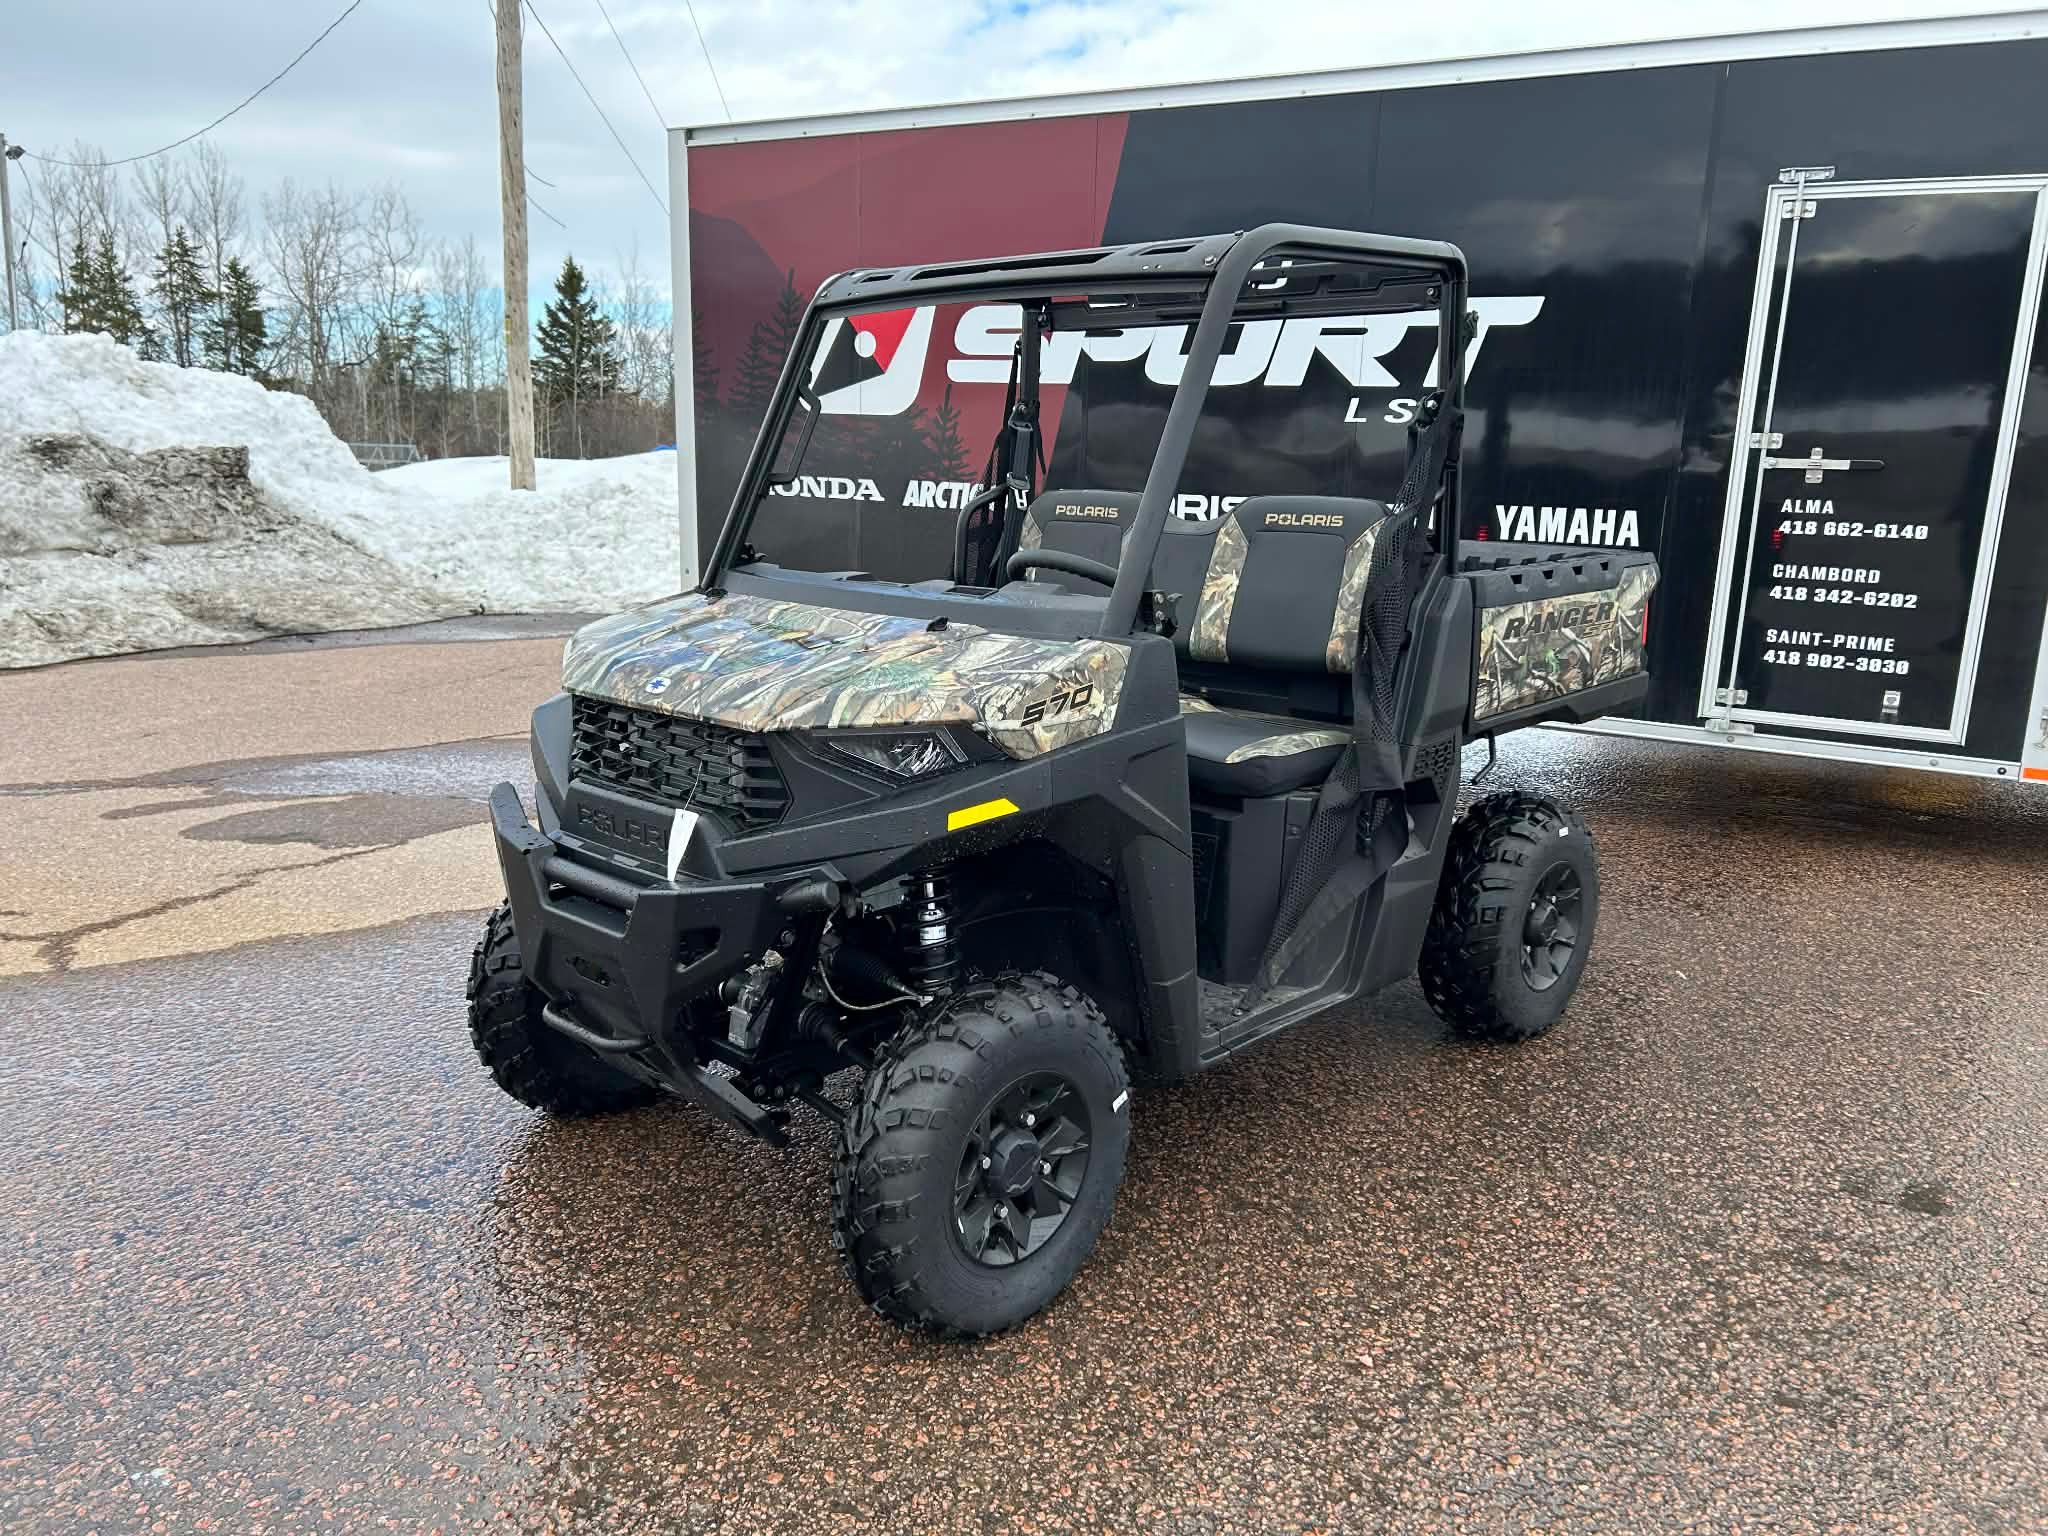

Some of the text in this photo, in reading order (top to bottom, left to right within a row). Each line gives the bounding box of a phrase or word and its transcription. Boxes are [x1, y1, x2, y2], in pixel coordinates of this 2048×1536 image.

[946, 295, 1545, 388] SPORT
[768, 476, 885, 502] ONDA
[1055, 505, 1119, 518] POLARIS
[1780, 499, 1834, 514] ALMA
[1264, 513, 1344, 527] POLARIS
[1495, 505, 1640, 547] YAMAHA
[1779, 520, 1929, 540] 418 662-6140
[1773, 564, 1881, 584] CHAMBORD
[1769, 585, 1918, 609] 418 342-6202
[1503, 602, 1614, 639] RANGER
[1766, 629, 1896, 652] SAINT-PRIME
[1763, 650, 1910, 675] 418 902-3030
[1021, 682, 1094, 727] 570
[577, 802, 670, 853] POLARI
